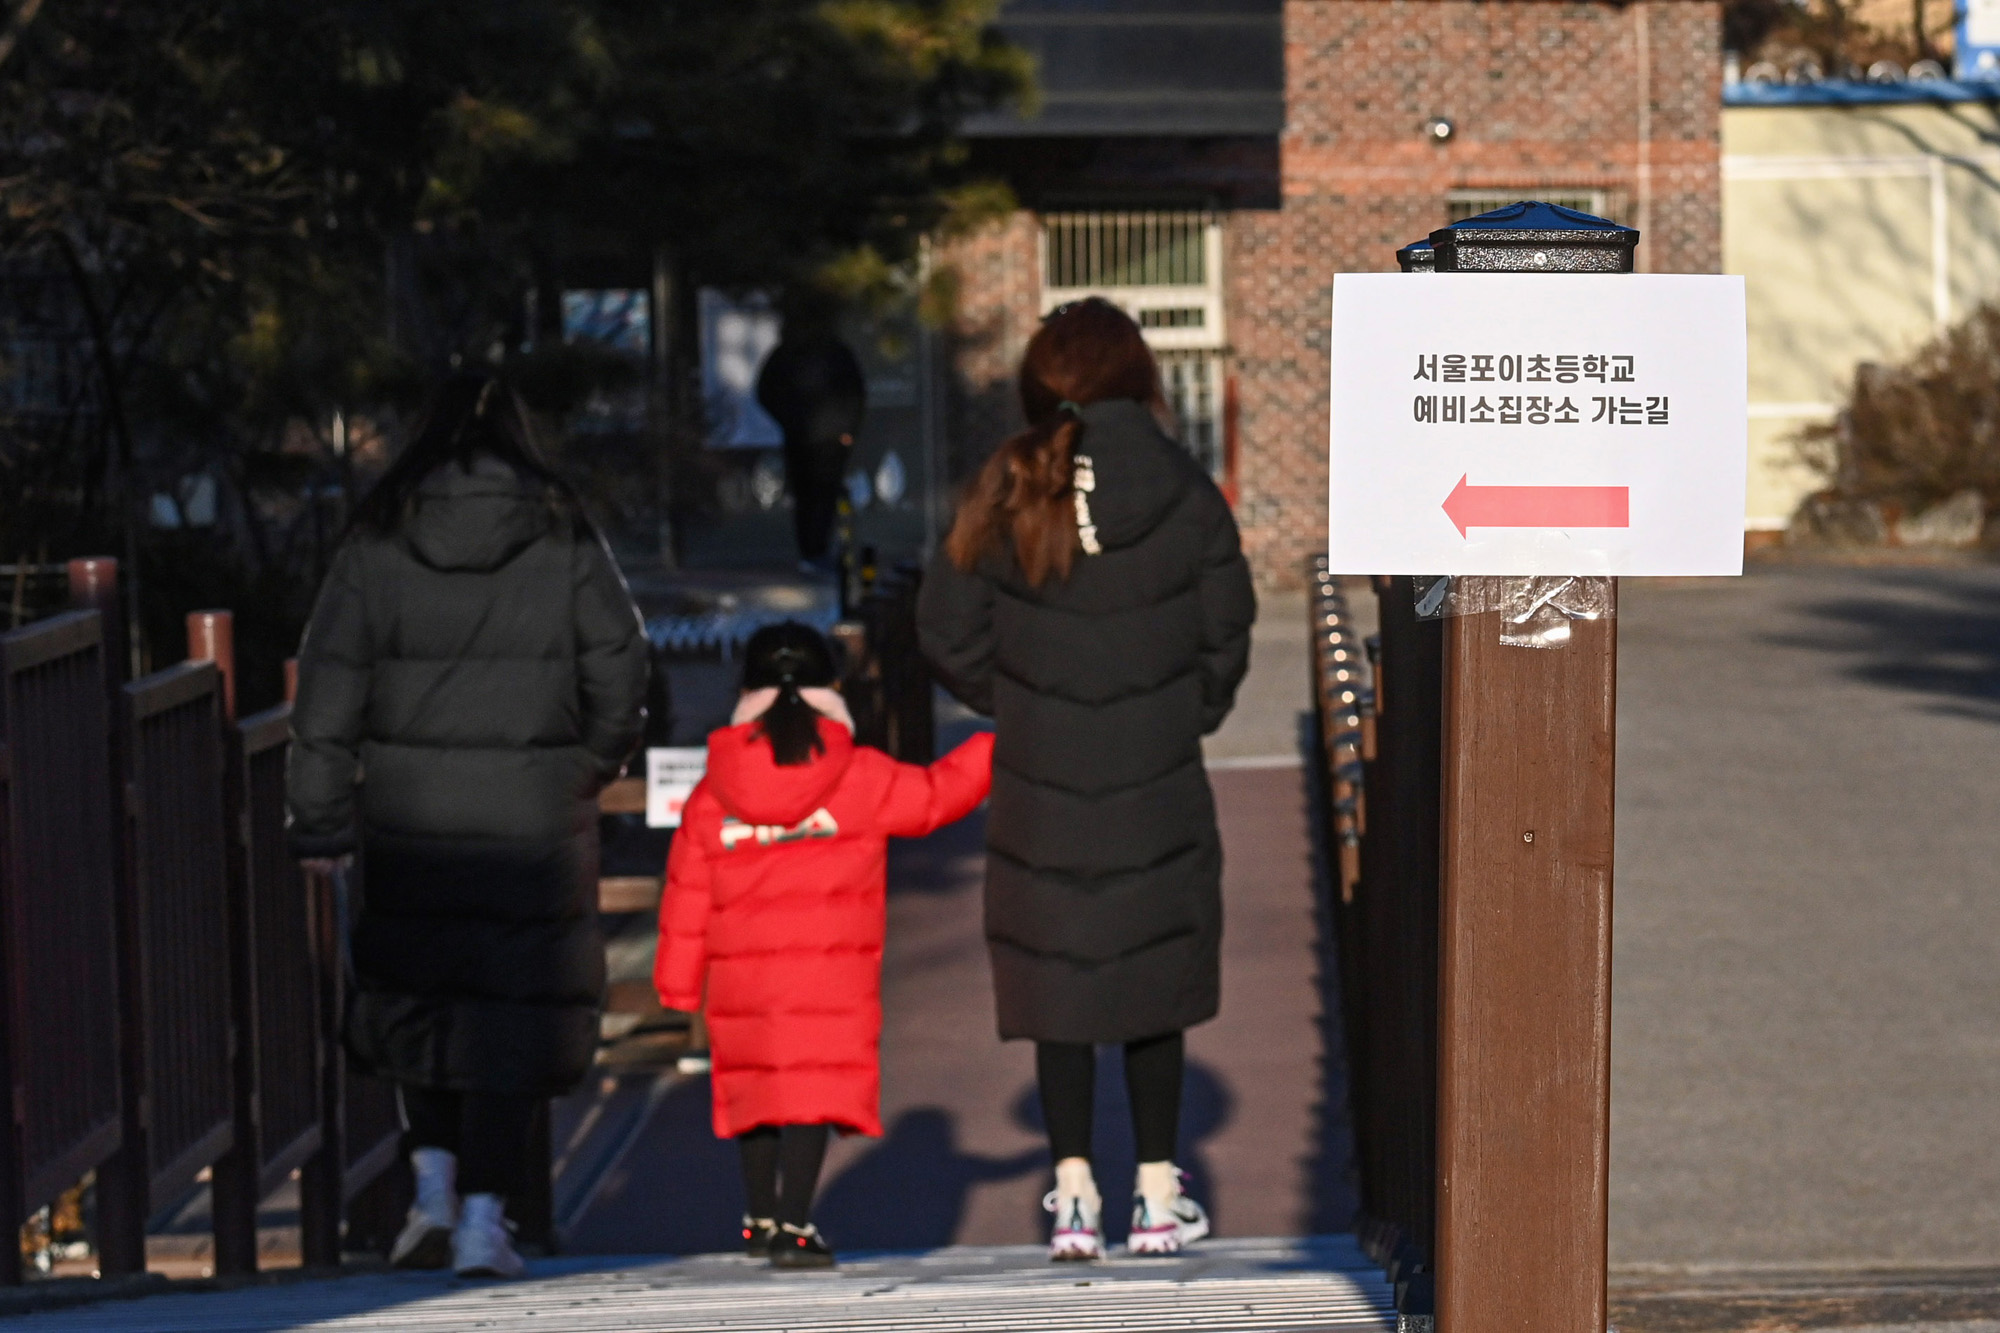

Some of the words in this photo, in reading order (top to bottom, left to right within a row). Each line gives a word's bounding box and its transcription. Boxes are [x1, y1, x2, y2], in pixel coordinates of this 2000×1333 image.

[1413, 353, 1635, 384] 서울포이초등학교
[1413, 395, 1580, 425] 예비소집장소
[1591, 395, 1669, 426] 가는길
